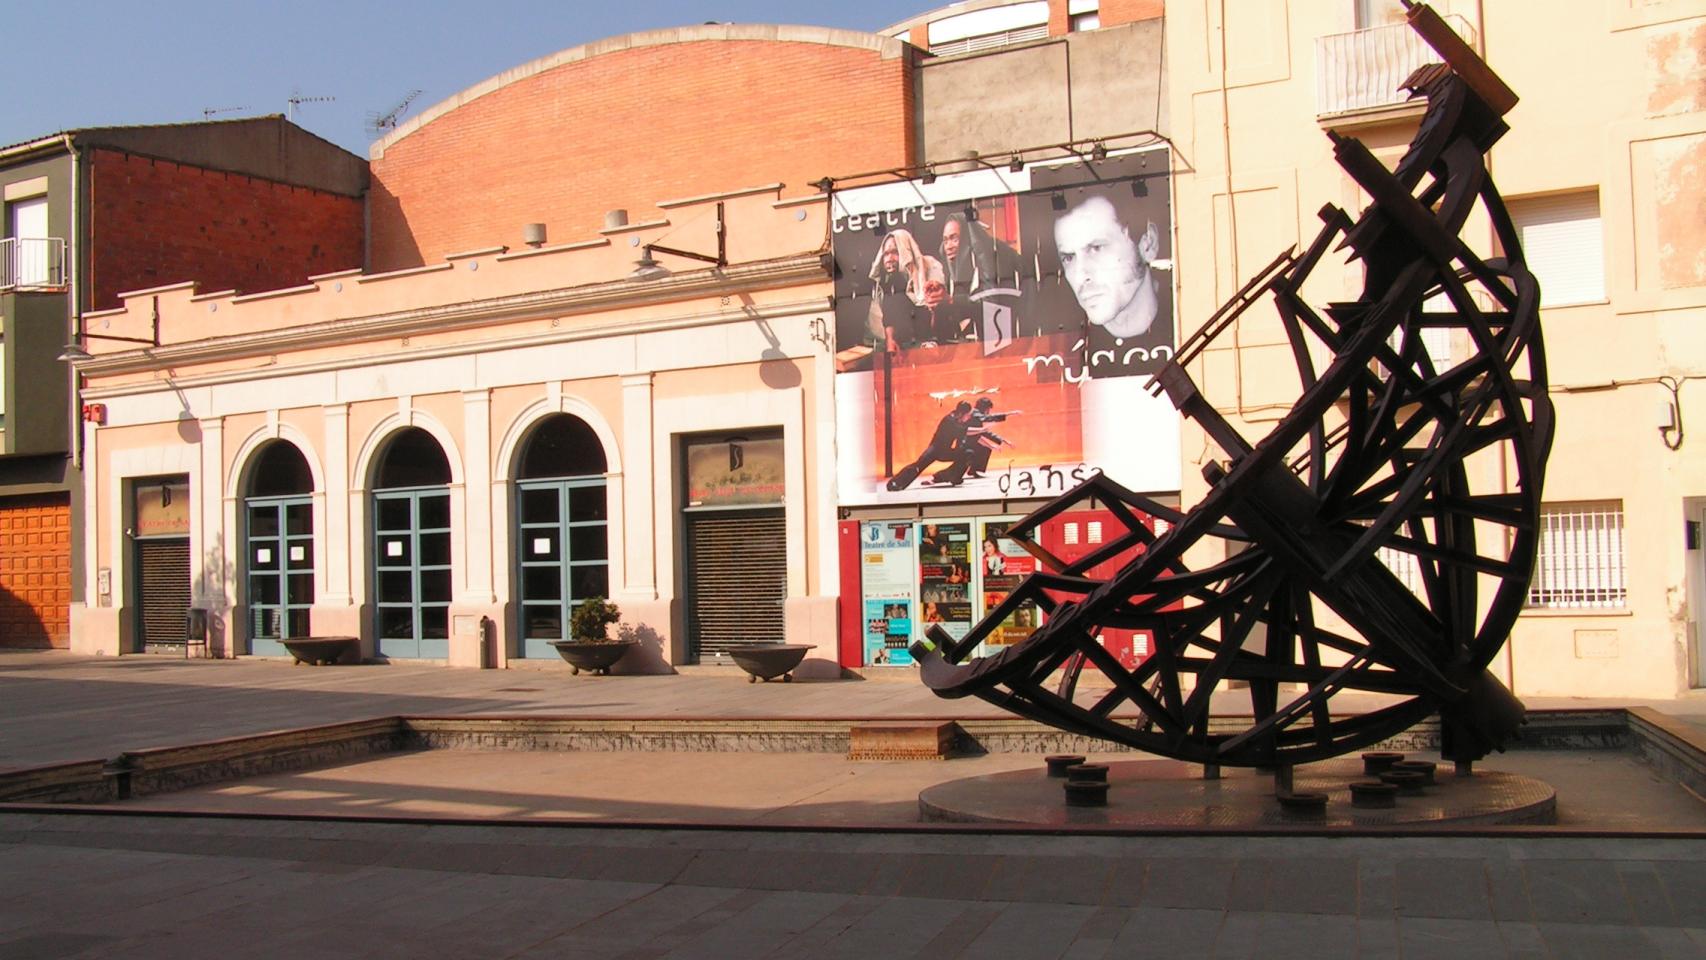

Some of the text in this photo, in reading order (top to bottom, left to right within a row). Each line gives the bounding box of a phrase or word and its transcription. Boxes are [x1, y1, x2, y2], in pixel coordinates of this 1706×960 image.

[832, 204, 936, 233] teatre
[1022, 338, 1173, 389] músca
[887, 540, 895, 548] de
